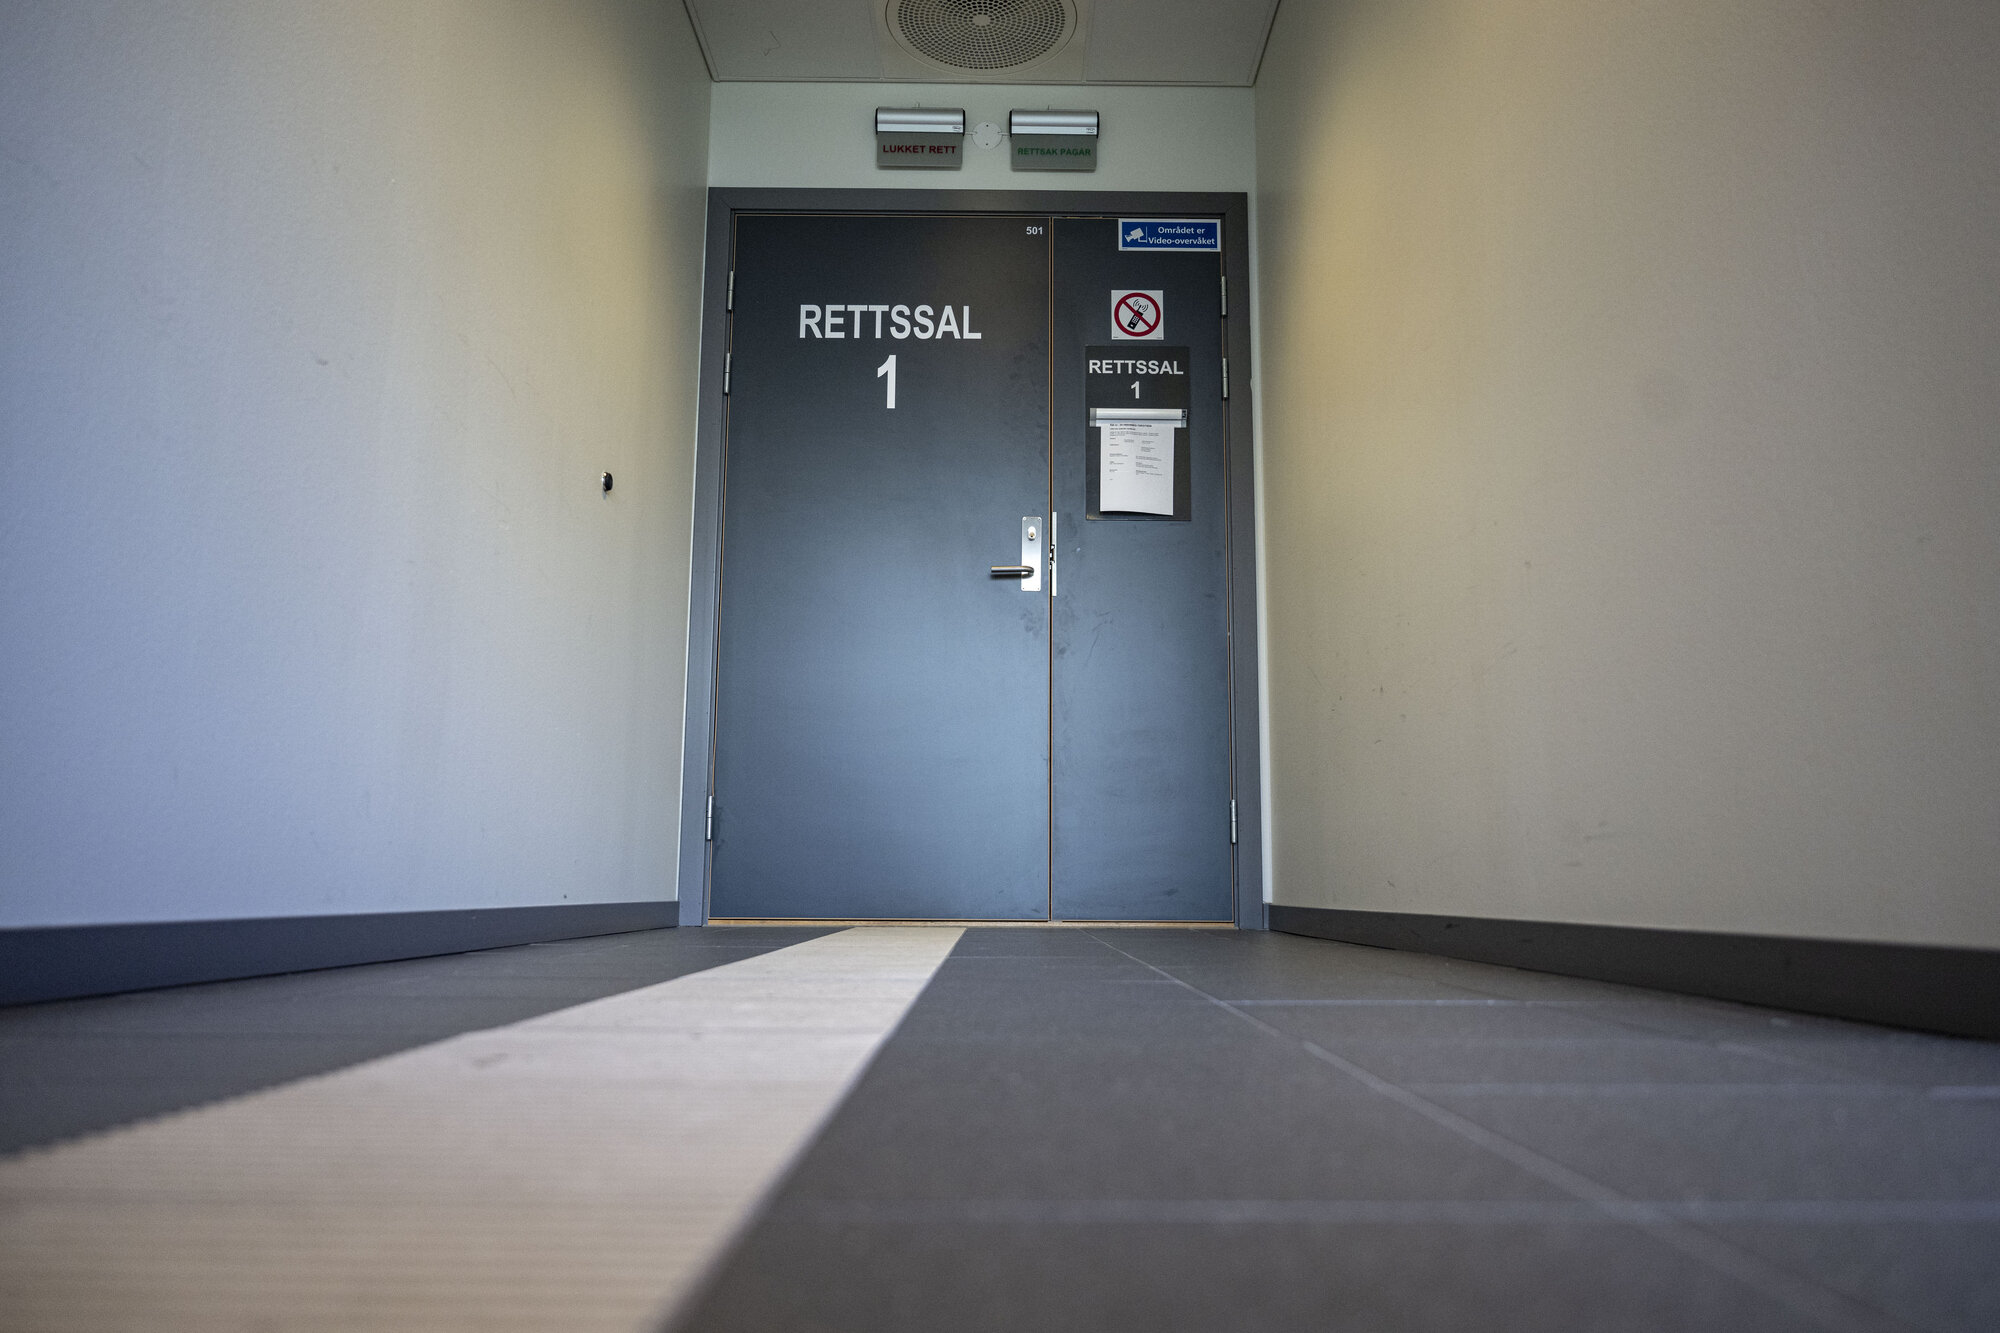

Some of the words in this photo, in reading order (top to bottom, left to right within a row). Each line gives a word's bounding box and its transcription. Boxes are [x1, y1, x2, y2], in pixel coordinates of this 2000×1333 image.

[882, 144, 926, 154] LUKKET
[928, 145, 957, 154] RETT
[1018, 147, 1058, 156] RETTSAK
[1026, 226, 1043, 235] 501
[1157, 225, 1195, 235] Området
[1148, 236, 1215, 246] Video-overvåket
[800, 304, 982, 340] RETTSSAL
[1089, 359, 1184, 375] RETTSSAL
[877, 354, 896, 409] 1
[1130, 381, 1140, 399] 1
